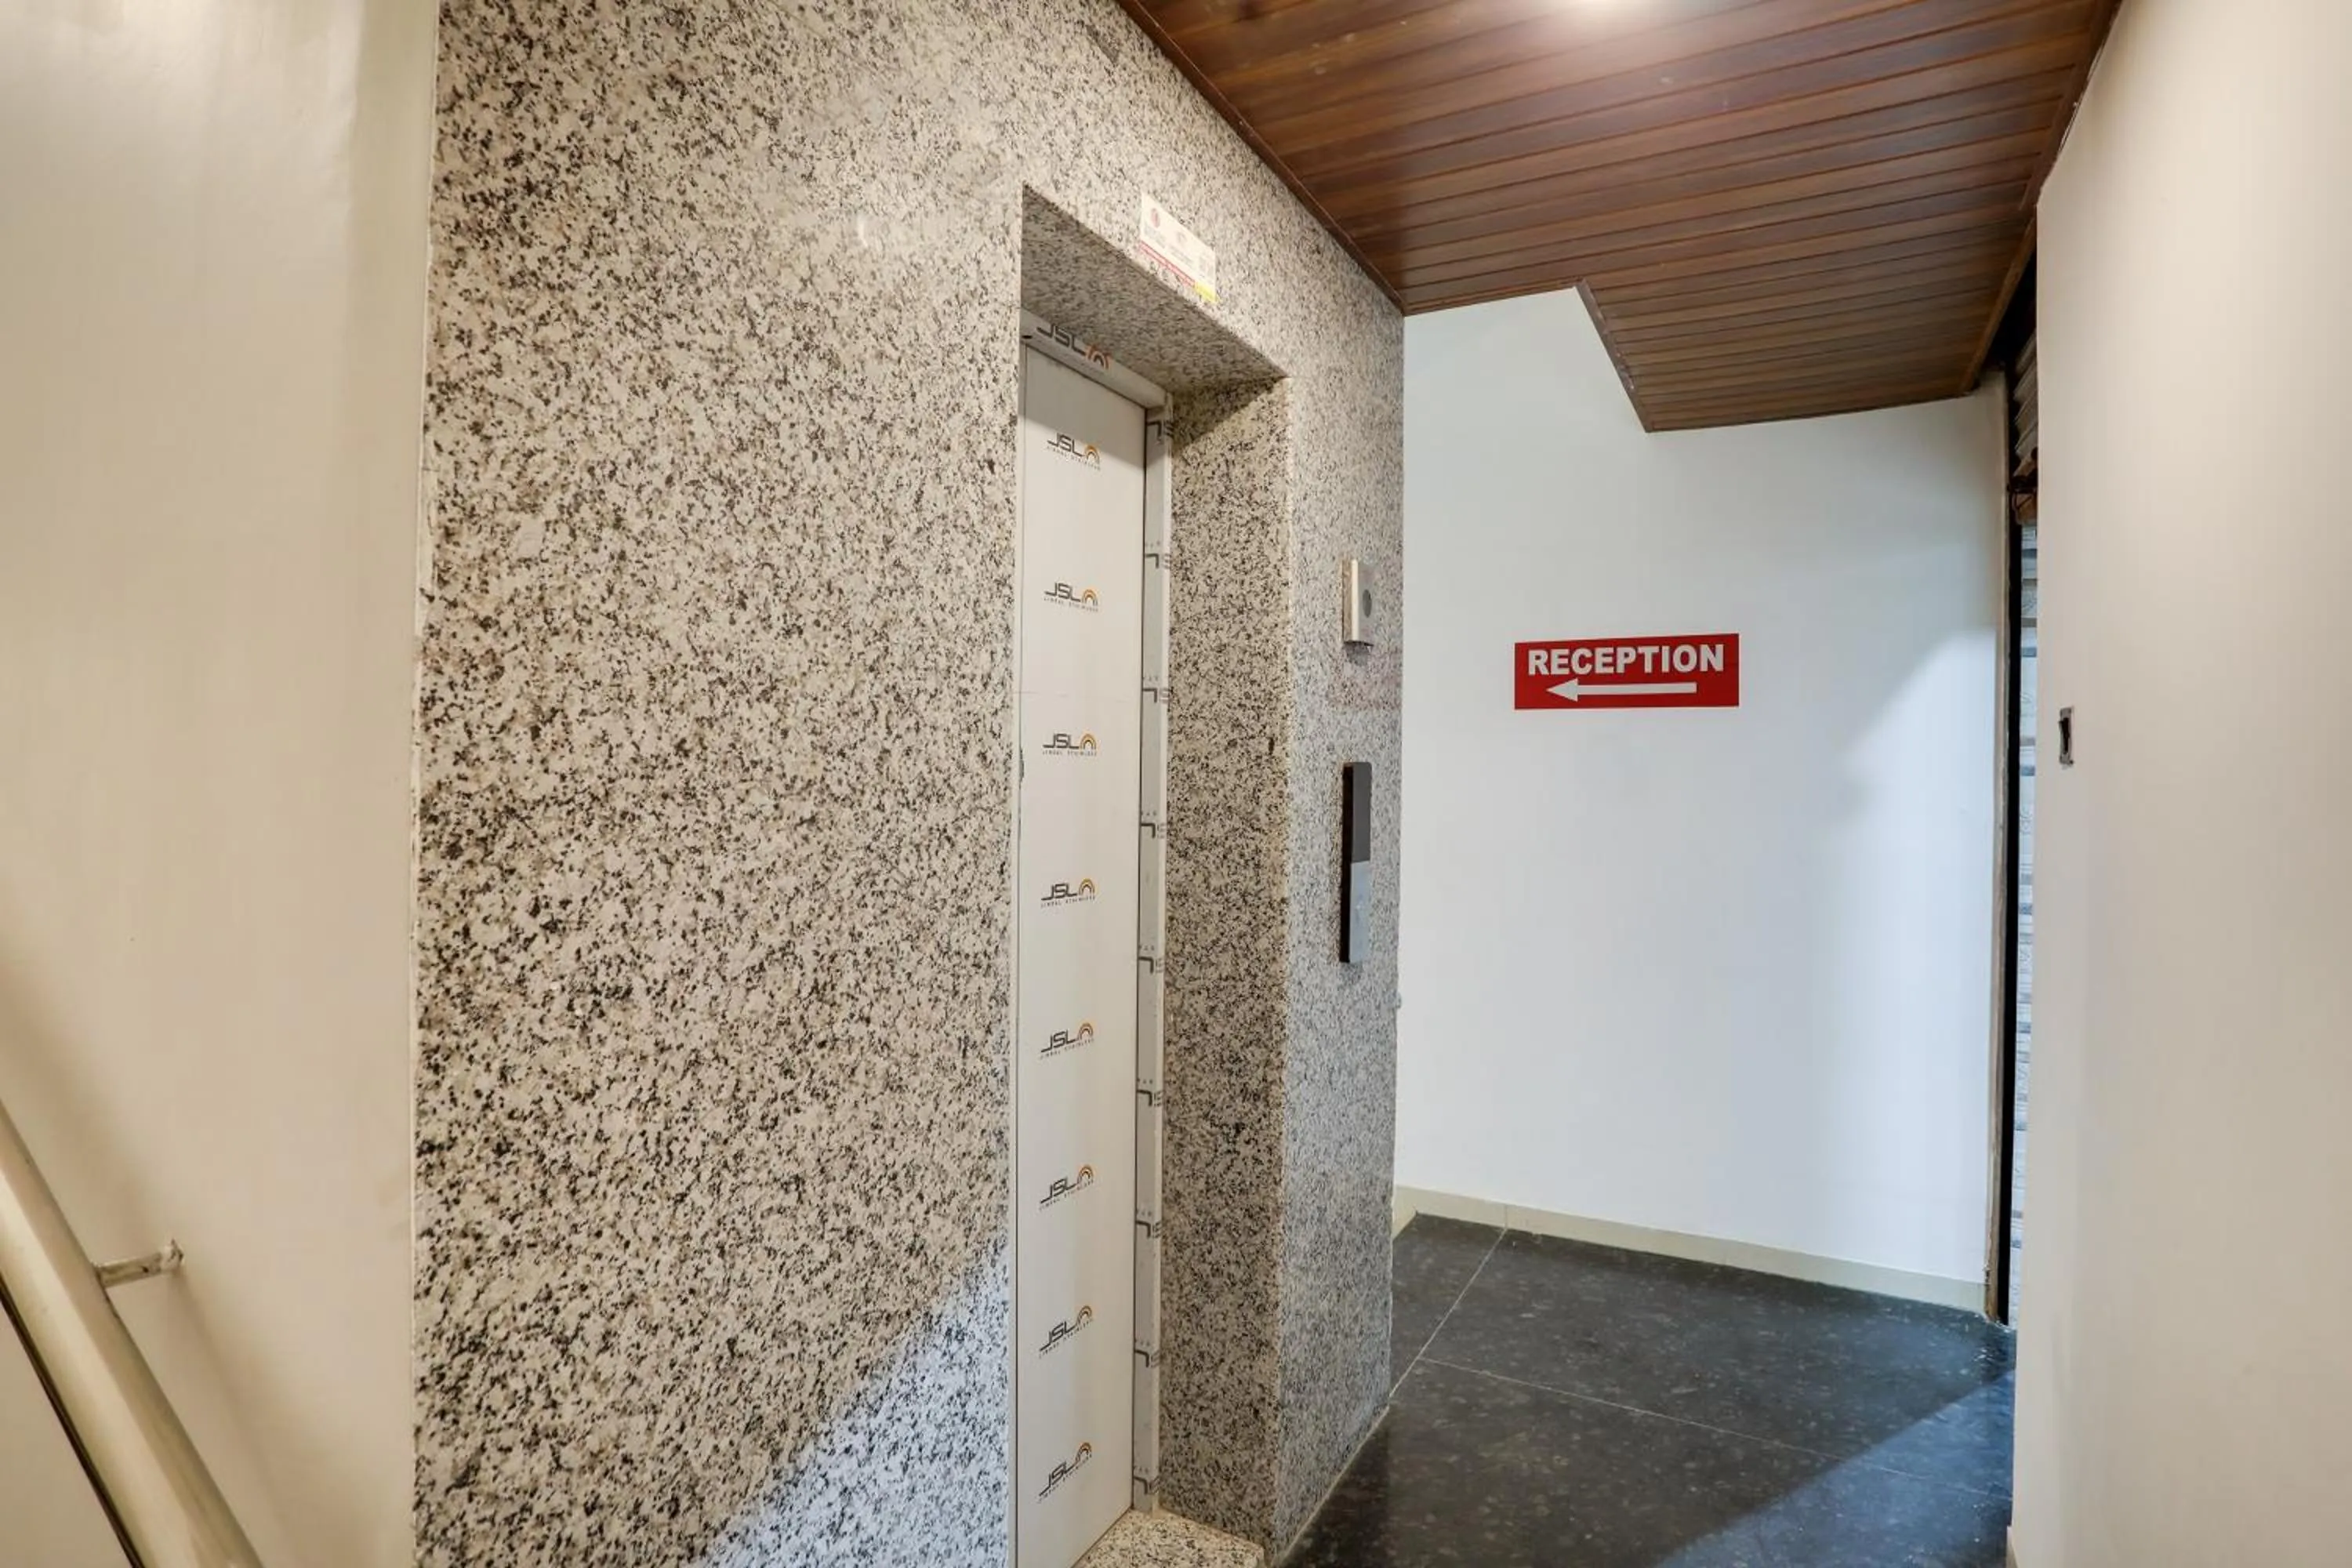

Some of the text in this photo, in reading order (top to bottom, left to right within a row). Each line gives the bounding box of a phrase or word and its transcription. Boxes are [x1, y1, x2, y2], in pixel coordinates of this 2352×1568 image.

[1036, 323, 1086, 356] JSL
[1047, 433, 1084, 457] JSL
[1044, 583, 1080, 602] JSL
[1528, 644, 1724, 676] RECEPTION
[1043, 733, 1080, 749] JSL
[1041, 883, 1077, 901] JSL
[1041, 1029, 1076, 1053] JSL
[1040, 1177, 1076, 1203] JSL
[1040, 1321, 1076, 1352] JSL
[1039, 1461, 1075, 1496] JSL
